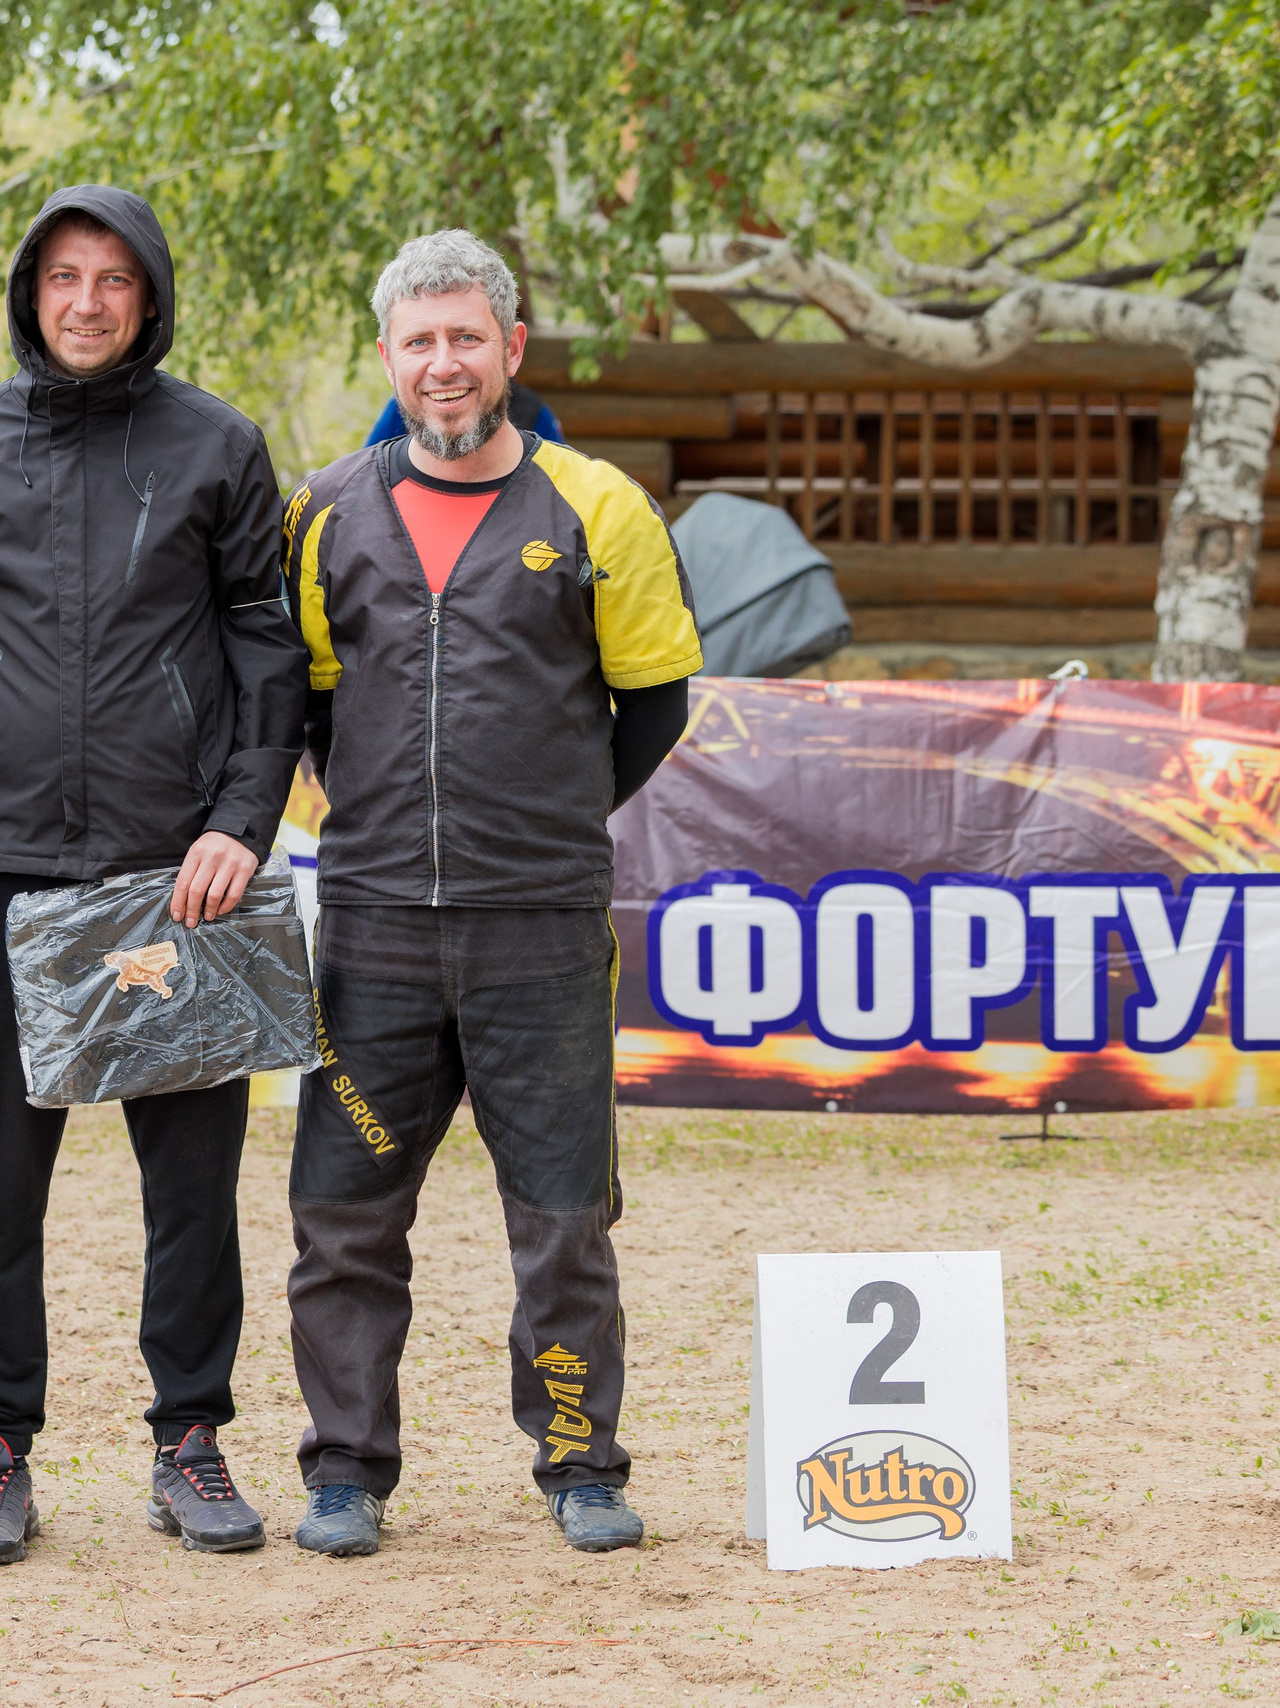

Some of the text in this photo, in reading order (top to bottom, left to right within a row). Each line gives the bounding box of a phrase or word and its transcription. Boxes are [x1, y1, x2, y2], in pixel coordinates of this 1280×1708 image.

[332, 1075, 396, 1156] SURKOV
[846, 1280, 926, 1405] 2
[797, 1444, 970, 1541] Nutro
